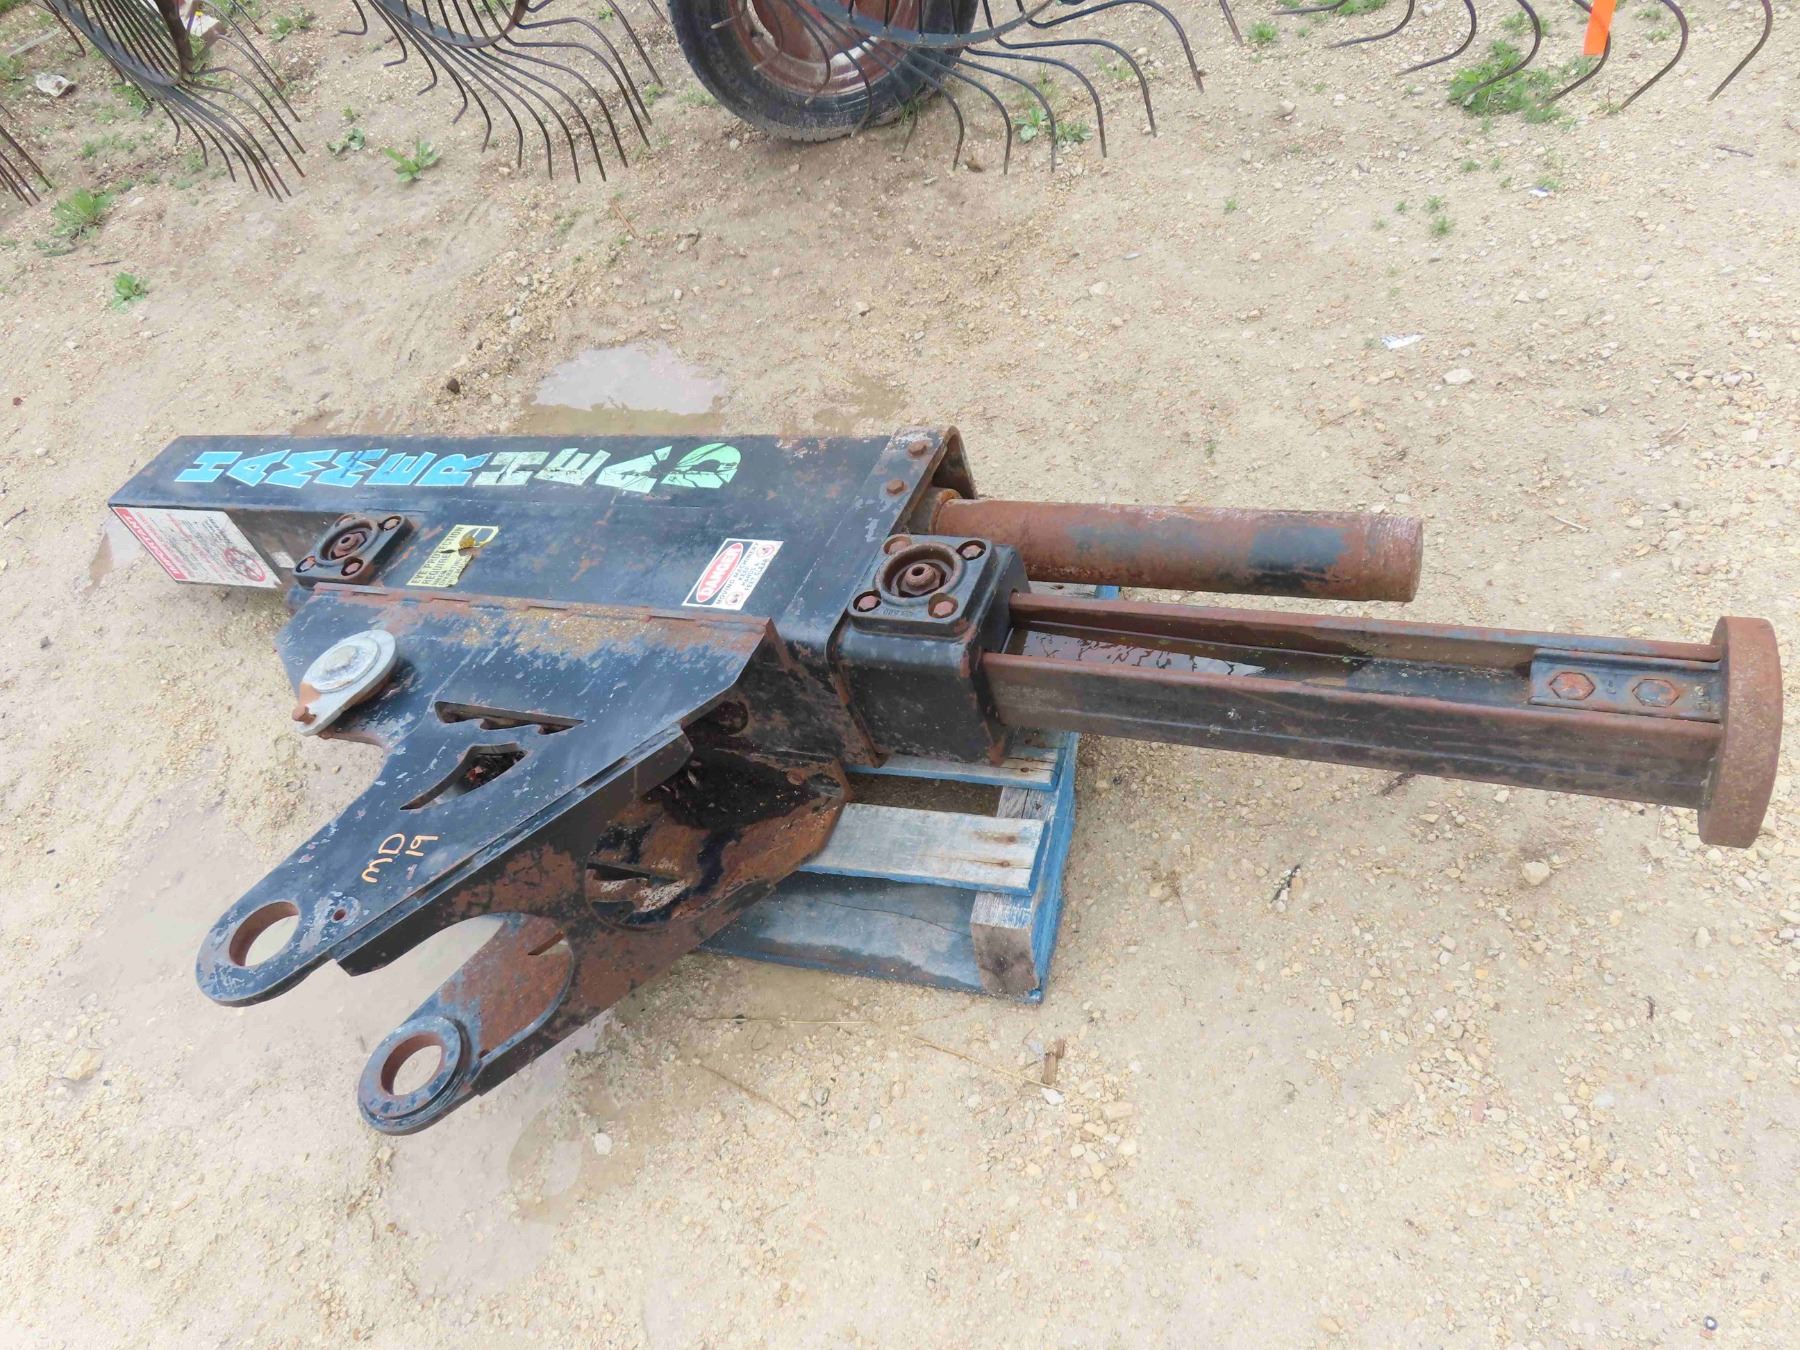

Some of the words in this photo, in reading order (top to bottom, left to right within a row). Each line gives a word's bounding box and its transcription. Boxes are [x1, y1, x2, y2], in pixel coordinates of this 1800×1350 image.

[411, 570, 428, 583] EYE
[700, 547, 741, 596] DANGER
[716, 579, 735, 605] MOVING
[733, 542, 759, 579] MACHINERY
[745, 576, 756, 591] FEET
